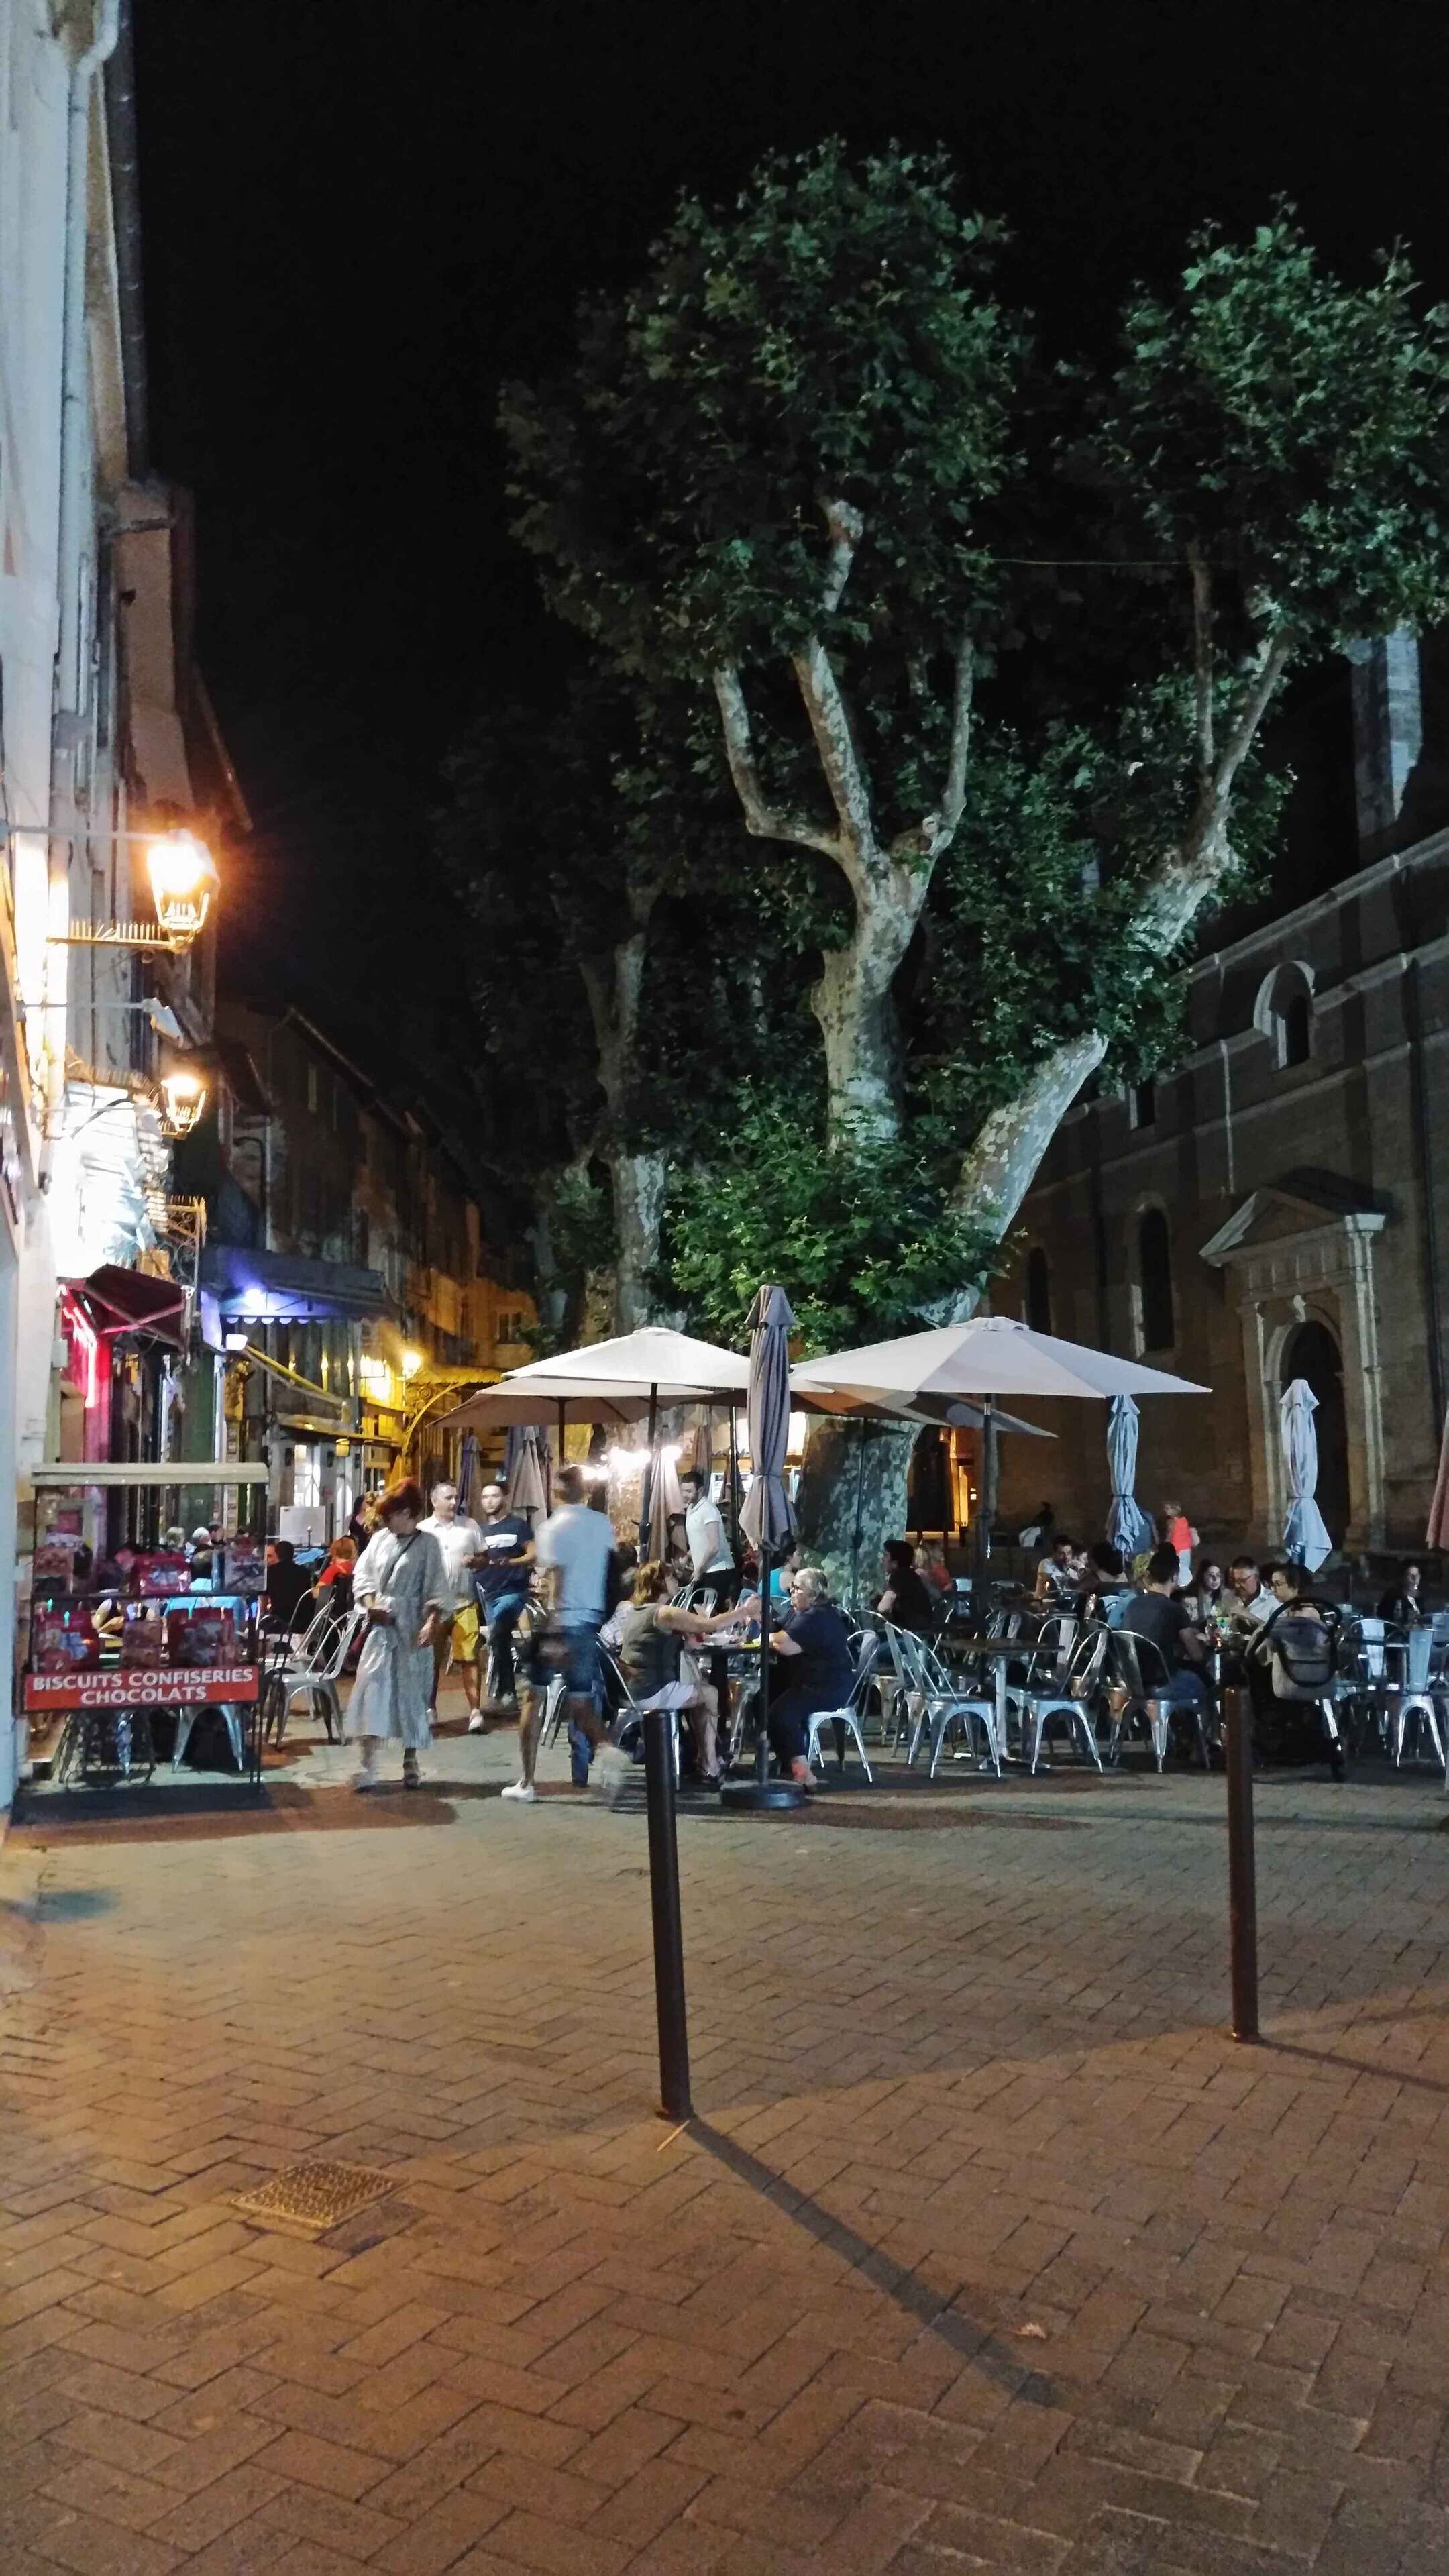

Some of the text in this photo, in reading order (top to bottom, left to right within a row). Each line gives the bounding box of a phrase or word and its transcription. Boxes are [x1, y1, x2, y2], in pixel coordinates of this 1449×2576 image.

[33, 1668, 253, 1691] BISCUITS CONFISERIES
[80, 1686, 207, 1705] CHOCOLATS
